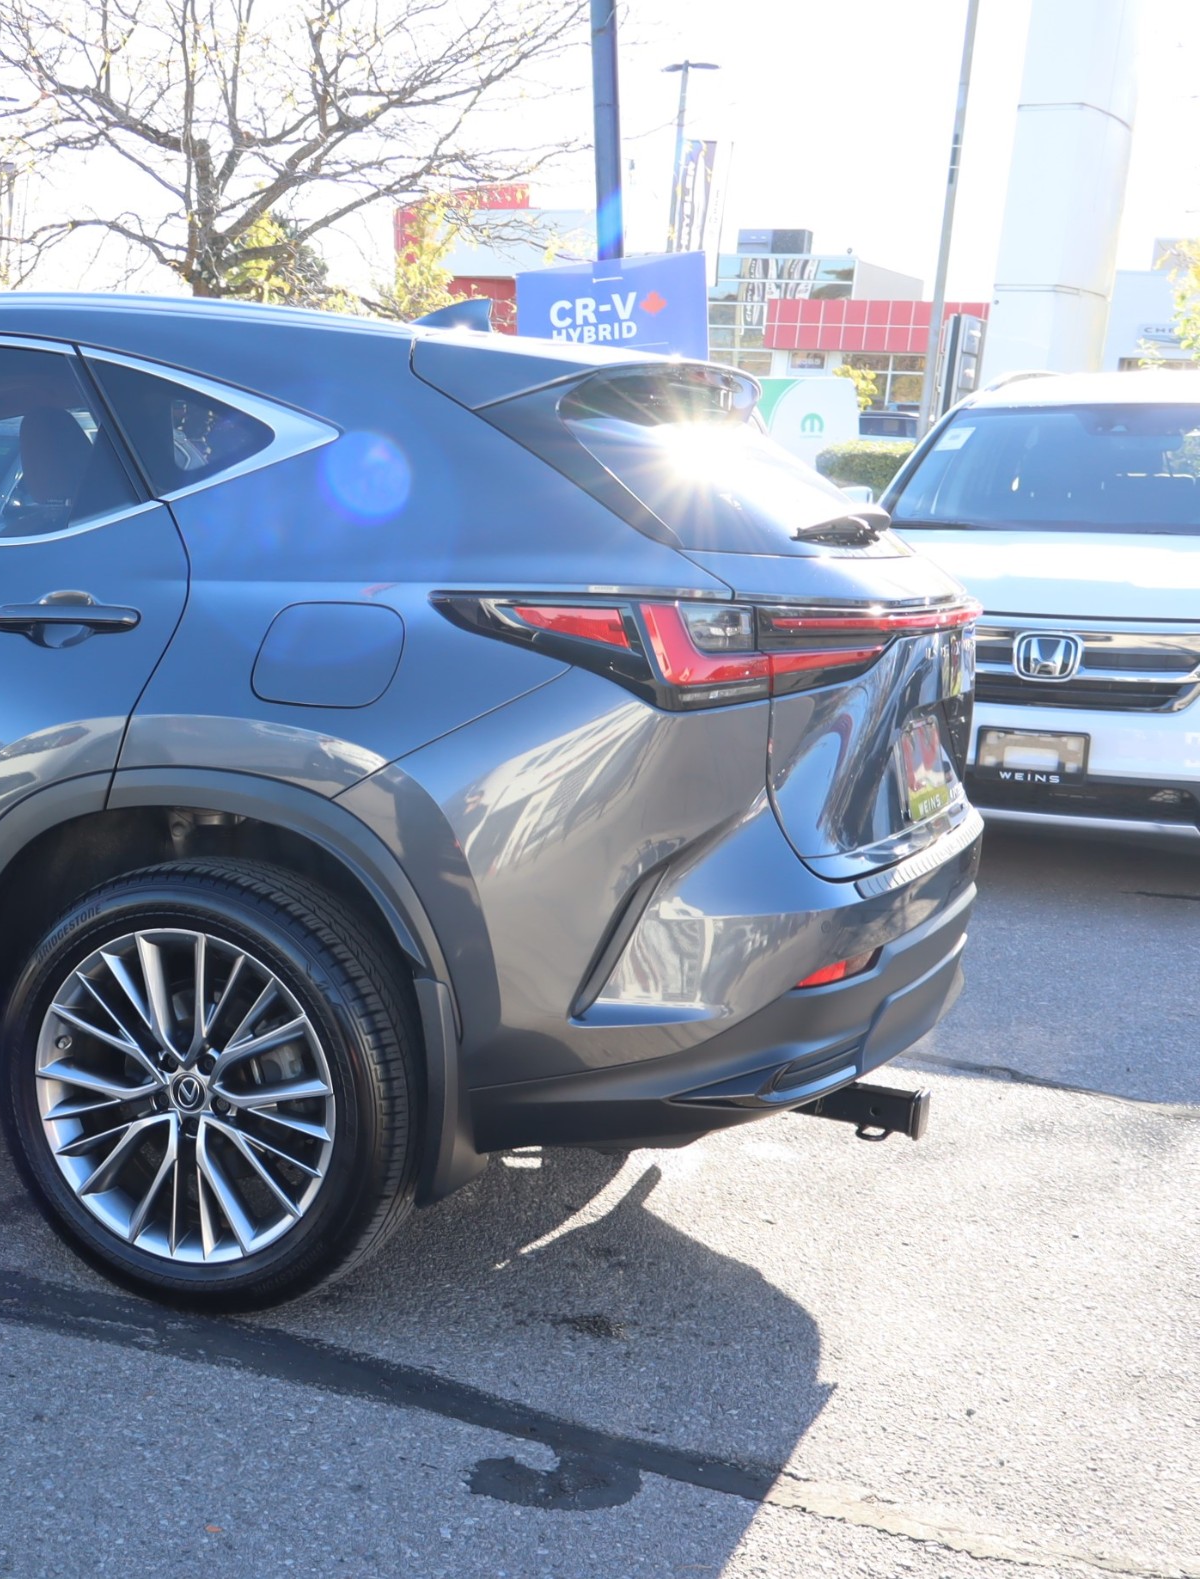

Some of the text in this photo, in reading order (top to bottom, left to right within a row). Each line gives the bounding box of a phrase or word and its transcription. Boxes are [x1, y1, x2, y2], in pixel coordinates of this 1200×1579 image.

[549, 291, 637, 329] CR-V
[552, 321, 638, 343] HYBRID
[999, 770, 1060, 784] WEINS
[918, 794, 940, 816] WEINS
[36, 905, 102, 962] BRIDGESTONE
